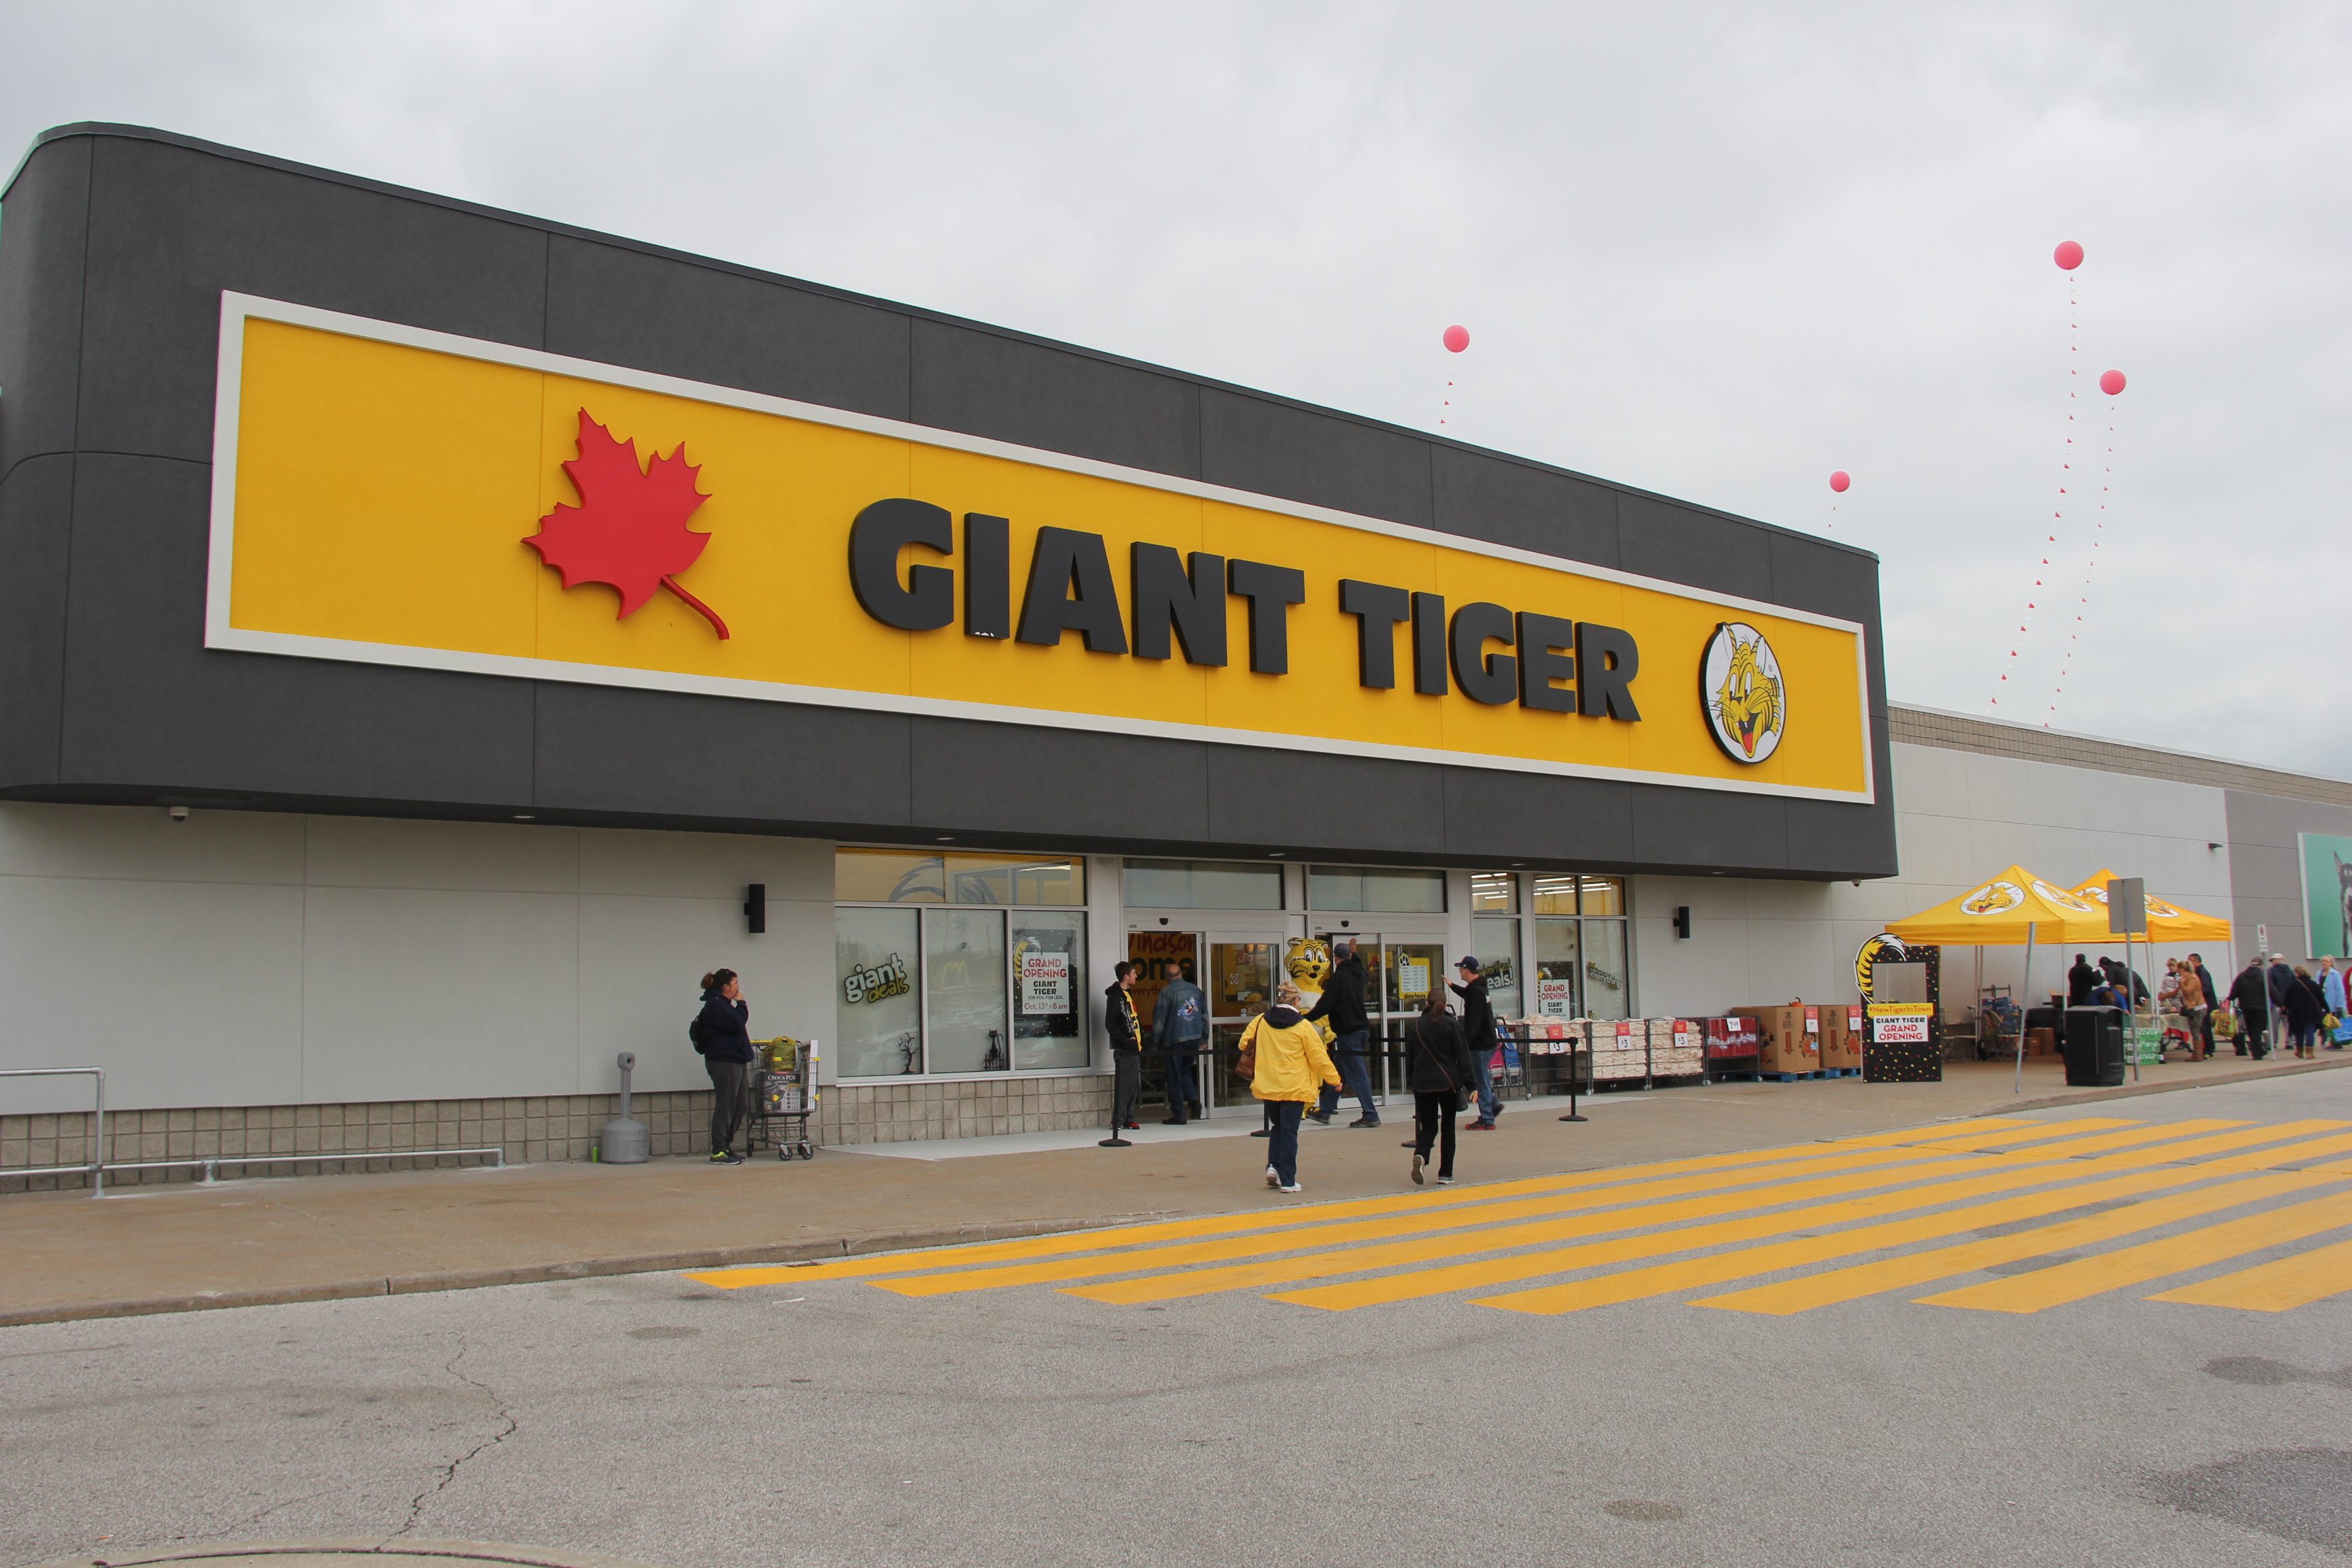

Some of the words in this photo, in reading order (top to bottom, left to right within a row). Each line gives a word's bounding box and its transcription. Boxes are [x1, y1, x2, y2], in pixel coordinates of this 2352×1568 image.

[848, 498, 1305, 676] GIANT
[1339, 578, 1642, 723] TIGER
[1128, 933, 1194, 955] indsor
[1028, 958, 1062, 967] GRAND
[1130, 957, 1195, 981] ome
[845, 952, 907, 1003] giant
[1024, 968, 1067, 978] OPENING
[1484, 966, 1514, 990] eals!
[1590, 972, 1622, 990] everything
[868, 973, 910, 1003] deals
[1541, 992, 1569, 1000] OPENING
[1544, 984, 1565, 992] GRAND
[1869, 1005, 1931, 1014] #NewTigerInTown
[1878, 1032, 1923, 1041] OPENING
